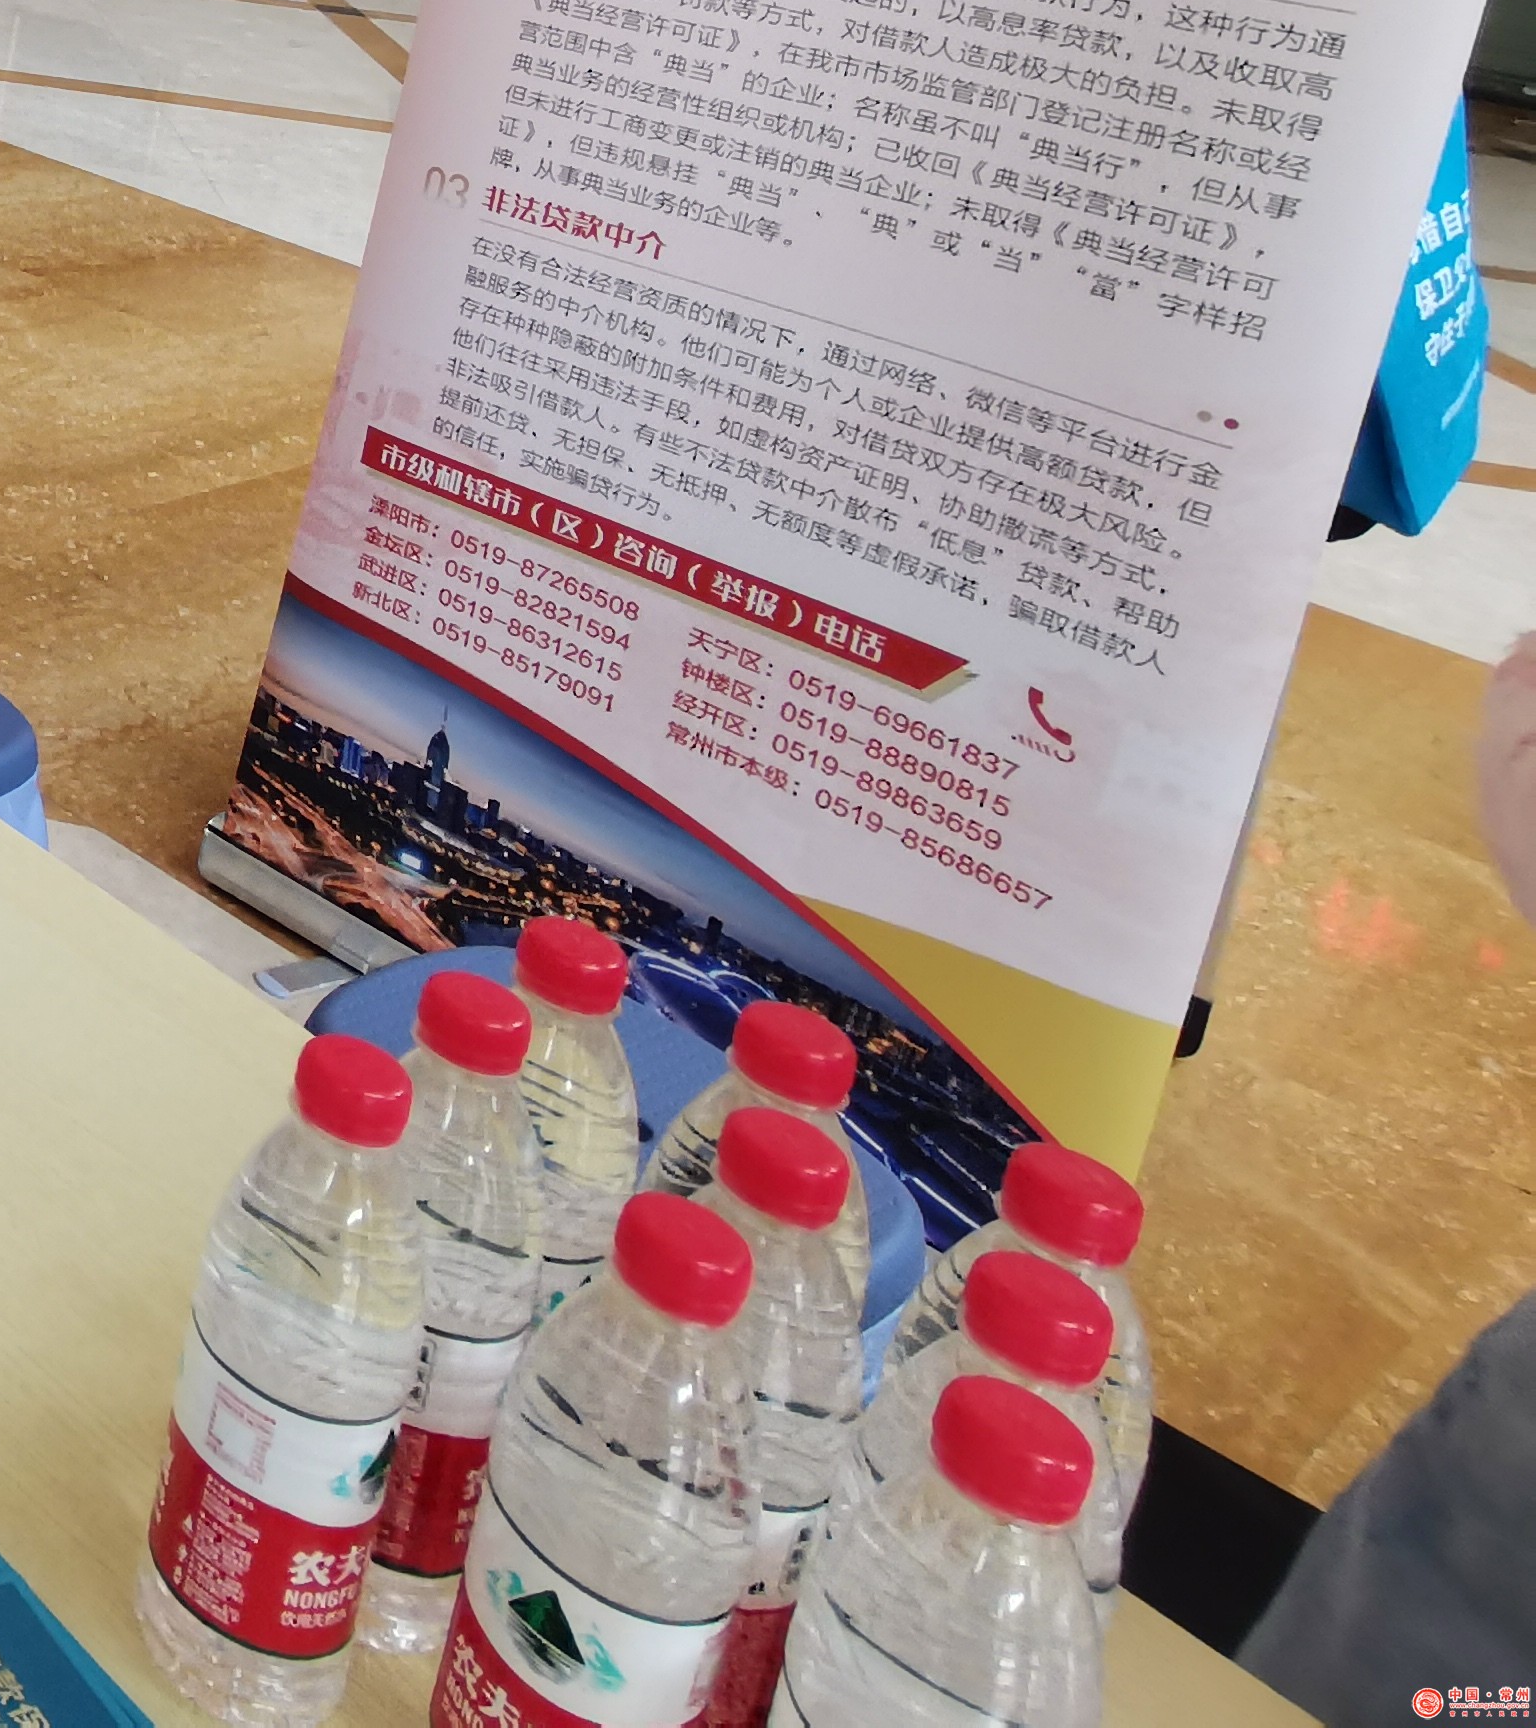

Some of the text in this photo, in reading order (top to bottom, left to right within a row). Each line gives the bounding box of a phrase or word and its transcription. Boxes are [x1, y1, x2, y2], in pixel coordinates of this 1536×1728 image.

[481, 186, 668, 261] 非法贷款中介
[489, 147, 795, 248] 牌，从事典当业务的企业等。
[432, 416, 673, 523] 的信任，实施骗贷行为。
